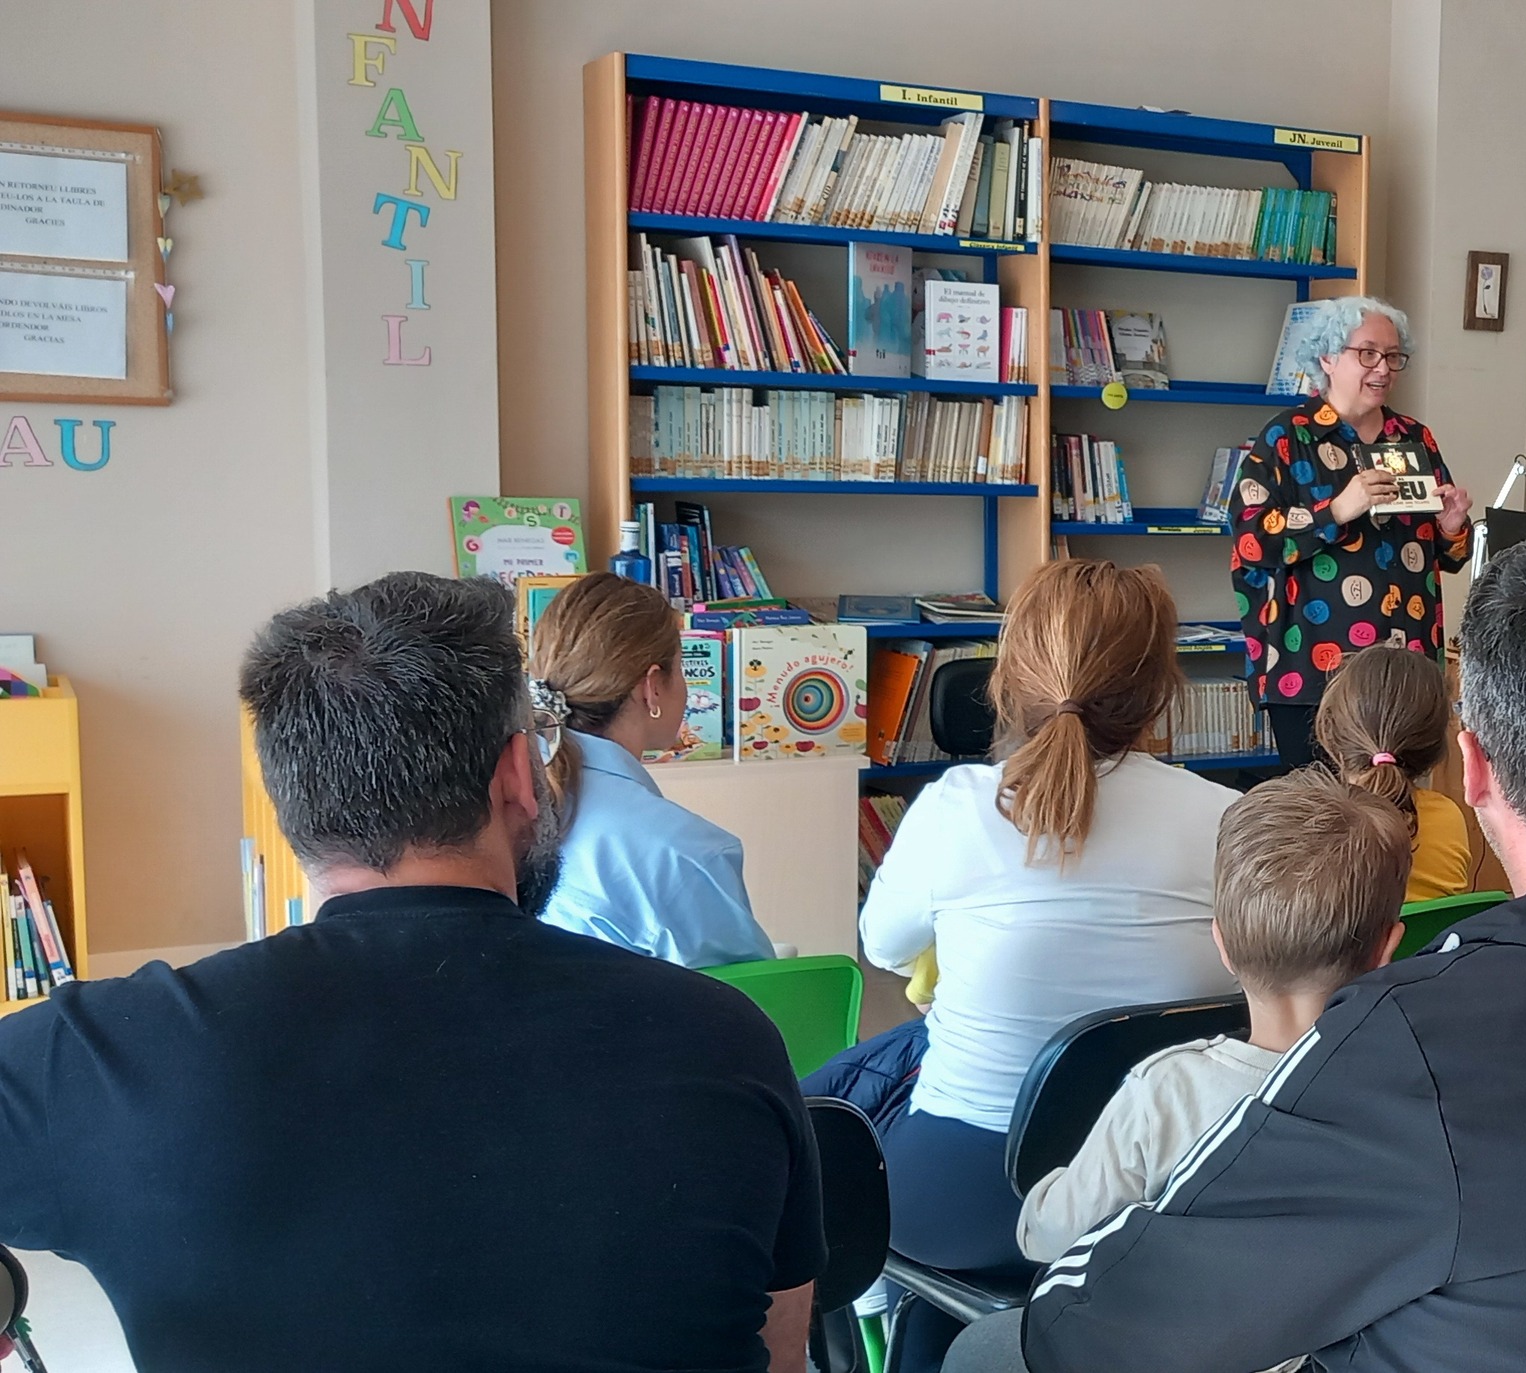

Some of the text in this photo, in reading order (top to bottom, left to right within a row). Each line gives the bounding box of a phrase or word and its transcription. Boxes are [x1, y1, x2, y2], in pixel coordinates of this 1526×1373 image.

[917, 93, 958, 106] Infantil
[1310, 137, 1343, 149] Juvenil
[60, 197, 91, 206] TAULA
[25, 217, 65, 226] GRACIES
[23, 334, 65, 343] GRACIAS
[0, 415, 117, 471] AU
[516, 558, 544, 566] PRIMER
[804, 654, 855, 673] agujero!
